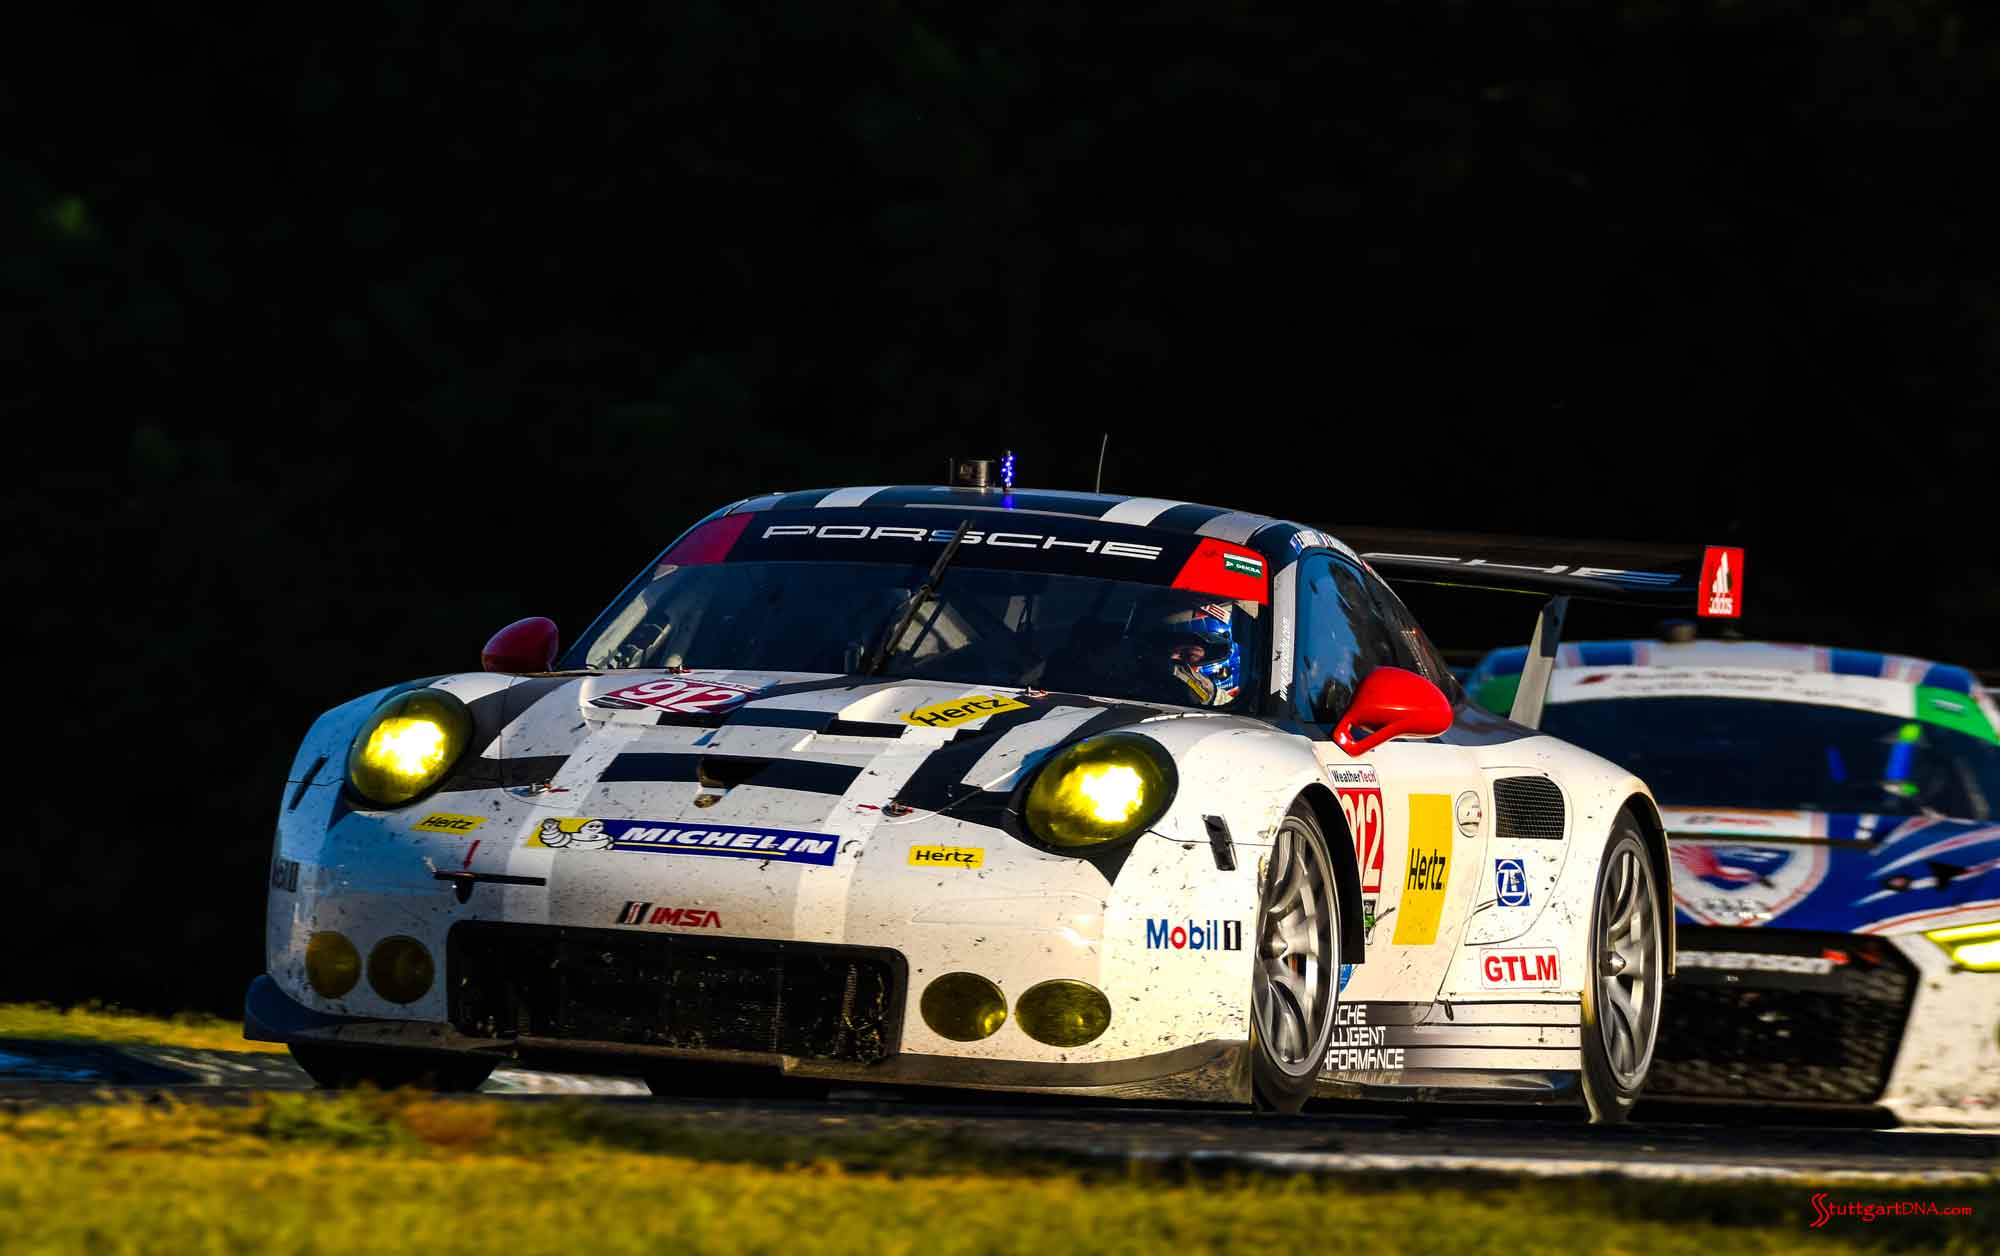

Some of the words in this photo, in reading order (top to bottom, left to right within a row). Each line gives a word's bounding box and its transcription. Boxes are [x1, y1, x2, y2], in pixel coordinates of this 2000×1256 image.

[761, 525, 1163, 561] PORSCHE
[619, 680, 747, 713] 912
[916, 699, 1009, 727] Hertz
[1332, 770, 1376, 783] WeatherTech
[421, 814, 474, 829] Hertz
[619, 827, 834, 855] MICHELIN
[915, 850, 976, 863] Hertz
[1408, 848, 1446, 891] Hertz
[648, 908, 722, 929] IMSA
[1146, 919, 1218, 950] Mobil
[1225, 920, 1240, 950] 1
[1484, 955, 1557, 982] GTLM
[1329, 1026, 1386, 1047] LLIGENT
